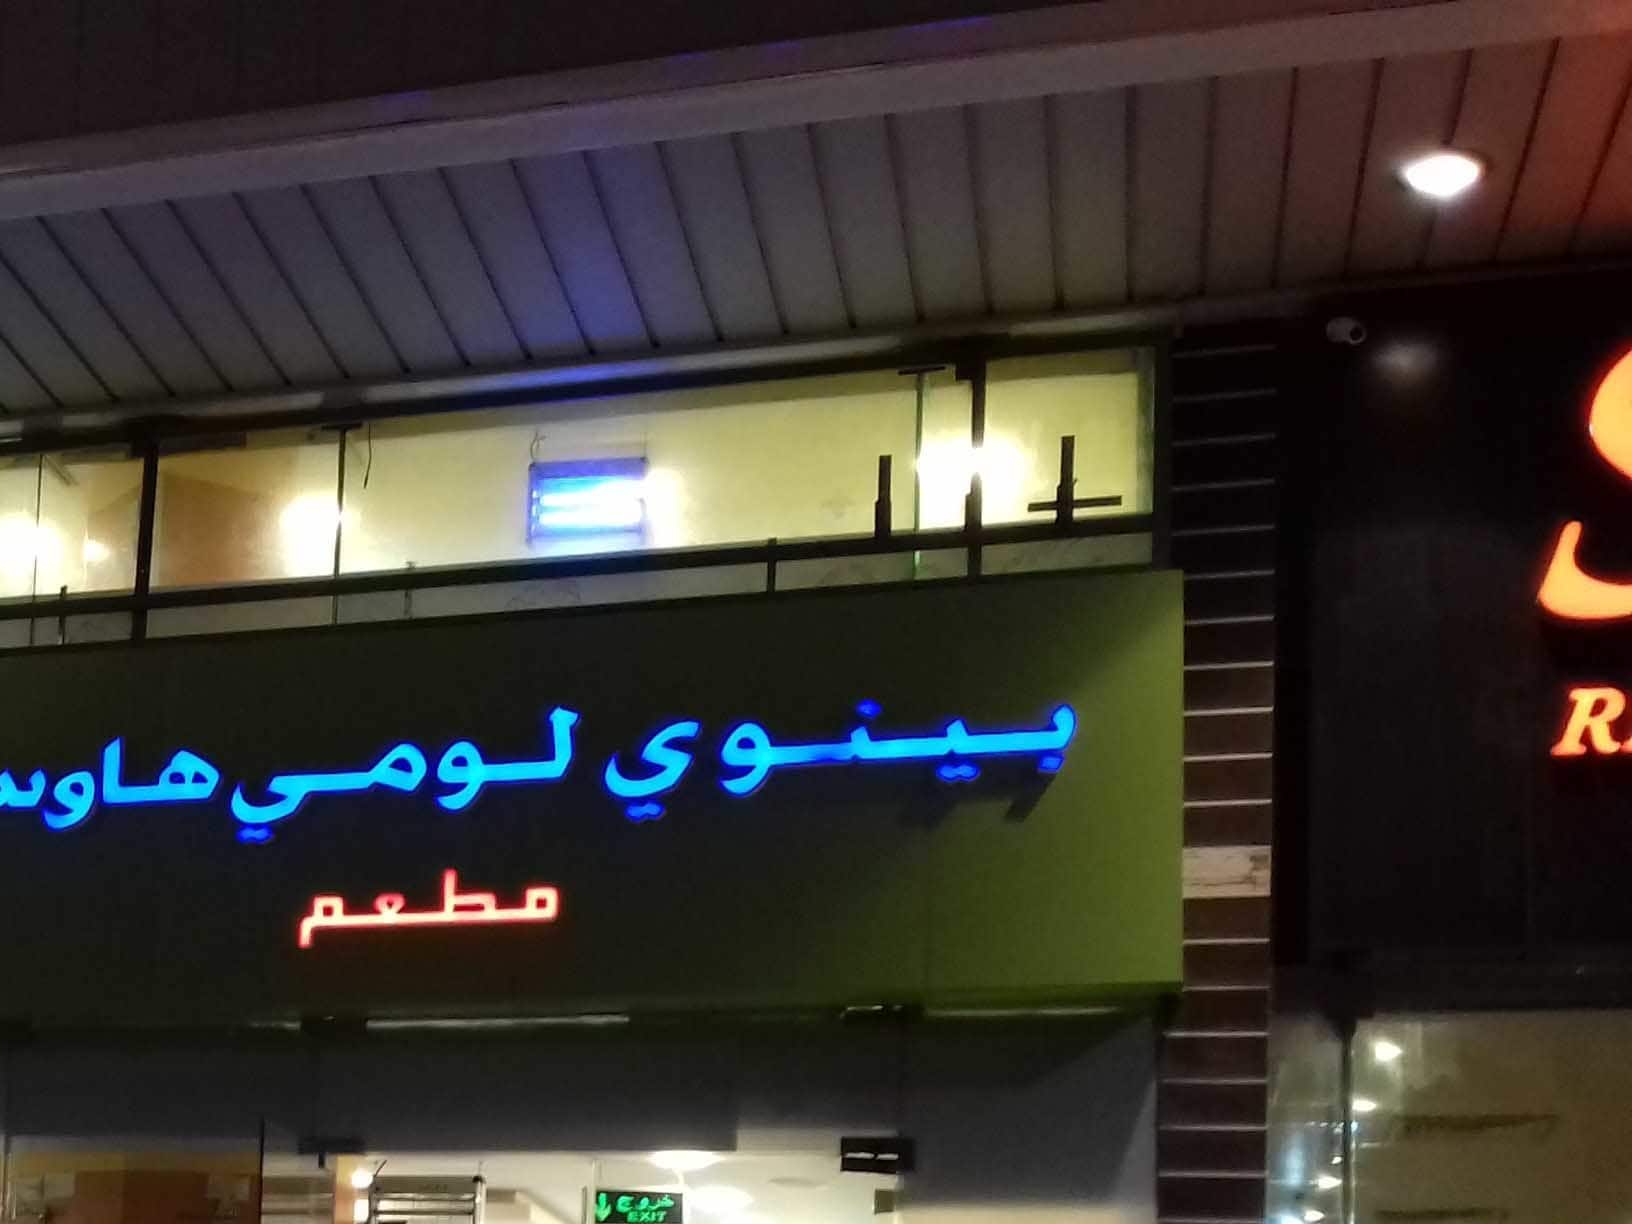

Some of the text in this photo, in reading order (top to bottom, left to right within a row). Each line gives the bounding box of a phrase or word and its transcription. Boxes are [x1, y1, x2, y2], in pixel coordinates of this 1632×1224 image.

[1551, 685, 1632, 758] R
[230, 705, 579, 843] لومي
[298, 868, 561, 949] مطعم
[626, 1210, 668, 1223] EXIT
